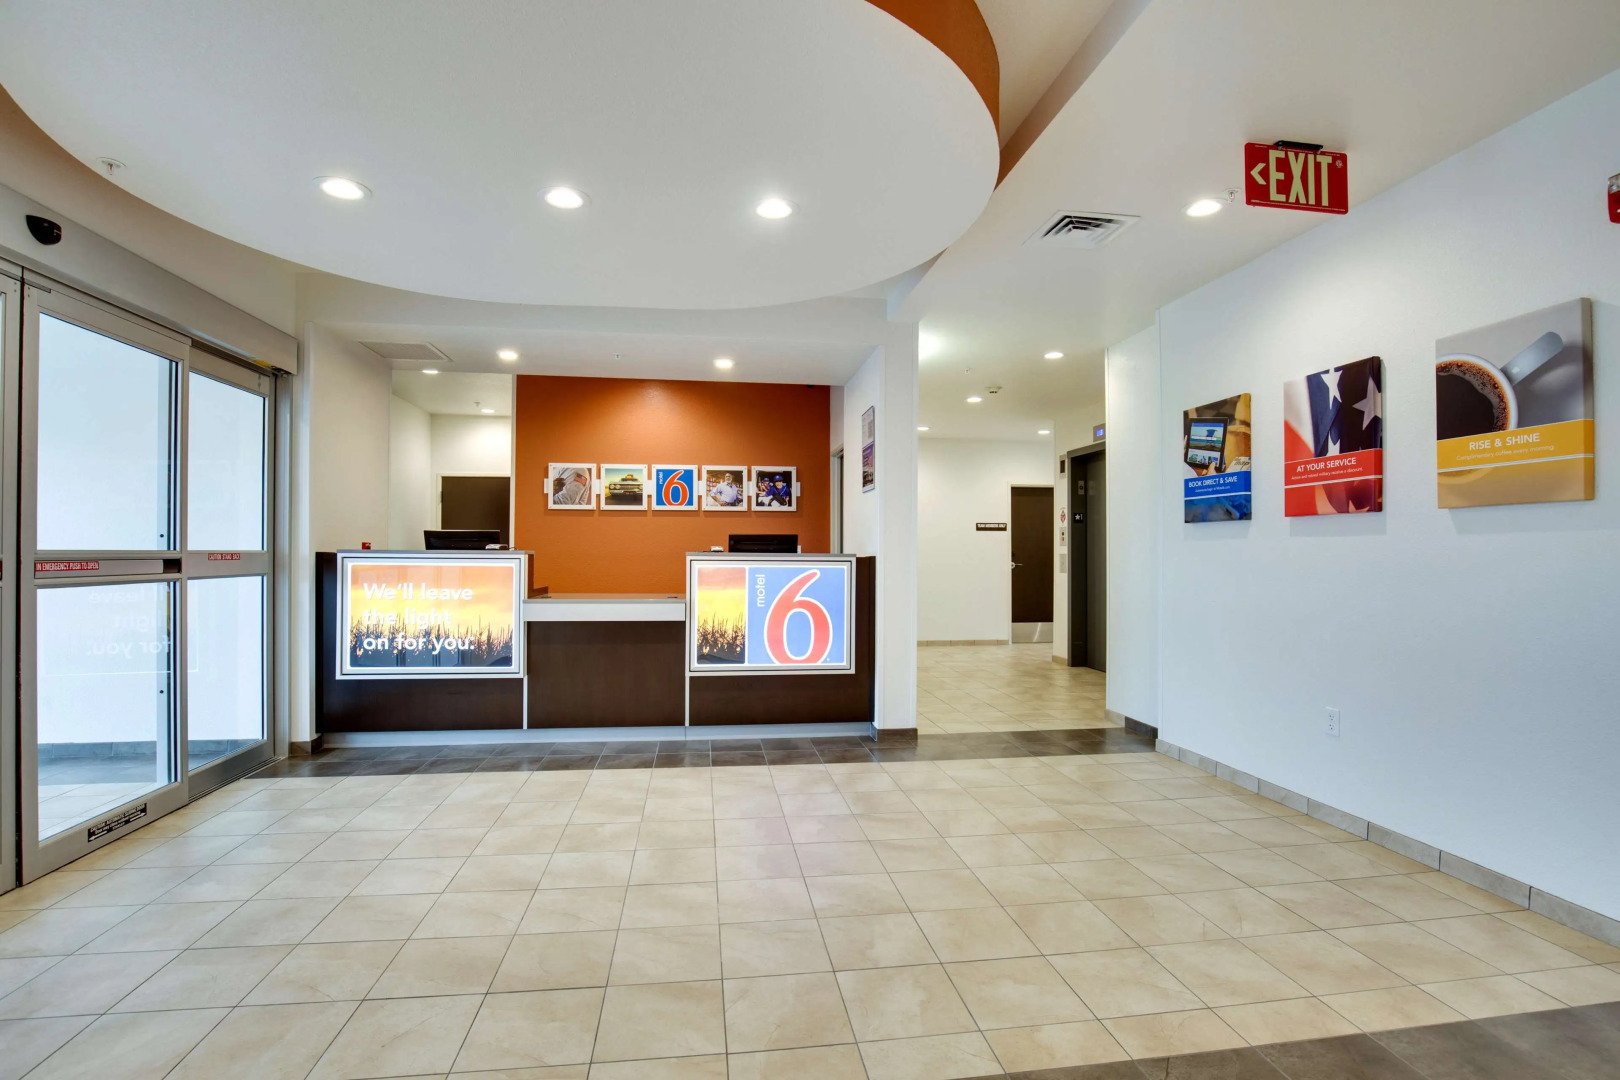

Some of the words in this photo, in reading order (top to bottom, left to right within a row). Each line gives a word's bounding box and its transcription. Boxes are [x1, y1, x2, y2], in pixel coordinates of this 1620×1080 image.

[1268, 149, 1333, 207] EXIT
[1469, 439, 1491, 451] RISE
[1494, 438, 1502, 448] &
[1506, 432, 1540, 446] SHINE
[1296, 464, 1305, 473] AT
[1306, 462, 1325, 472] YOUR
[1326, 457, 1357, 469] SERVICE
[662, 469, 689, 506] 6
[1188, 479, 1202, 488] BOOK
[1203, 477, 1219, 487] DIRECT
[1220, 476, 1224, 484] &
[1225, 475, 1238, 484] SAVE
[36, 562, 42, 571] IN
[42, 562, 69, 571] EMERGENCY
[69, 562, 81, 570] PUSH
[81, 561, 87, 570] TO
[88, 561, 99, 569] OPEN
[363, 582, 414, 601] We'll
[421, 582, 474, 601] leave
[363, 608, 398, 625] the
[405, 608, 451, 630] light
[755, 574, 766, 607] motel
[764, 569, 833, 664] 6
[363, 637, 389, 650] on
[397, 632, 427, 650] for
